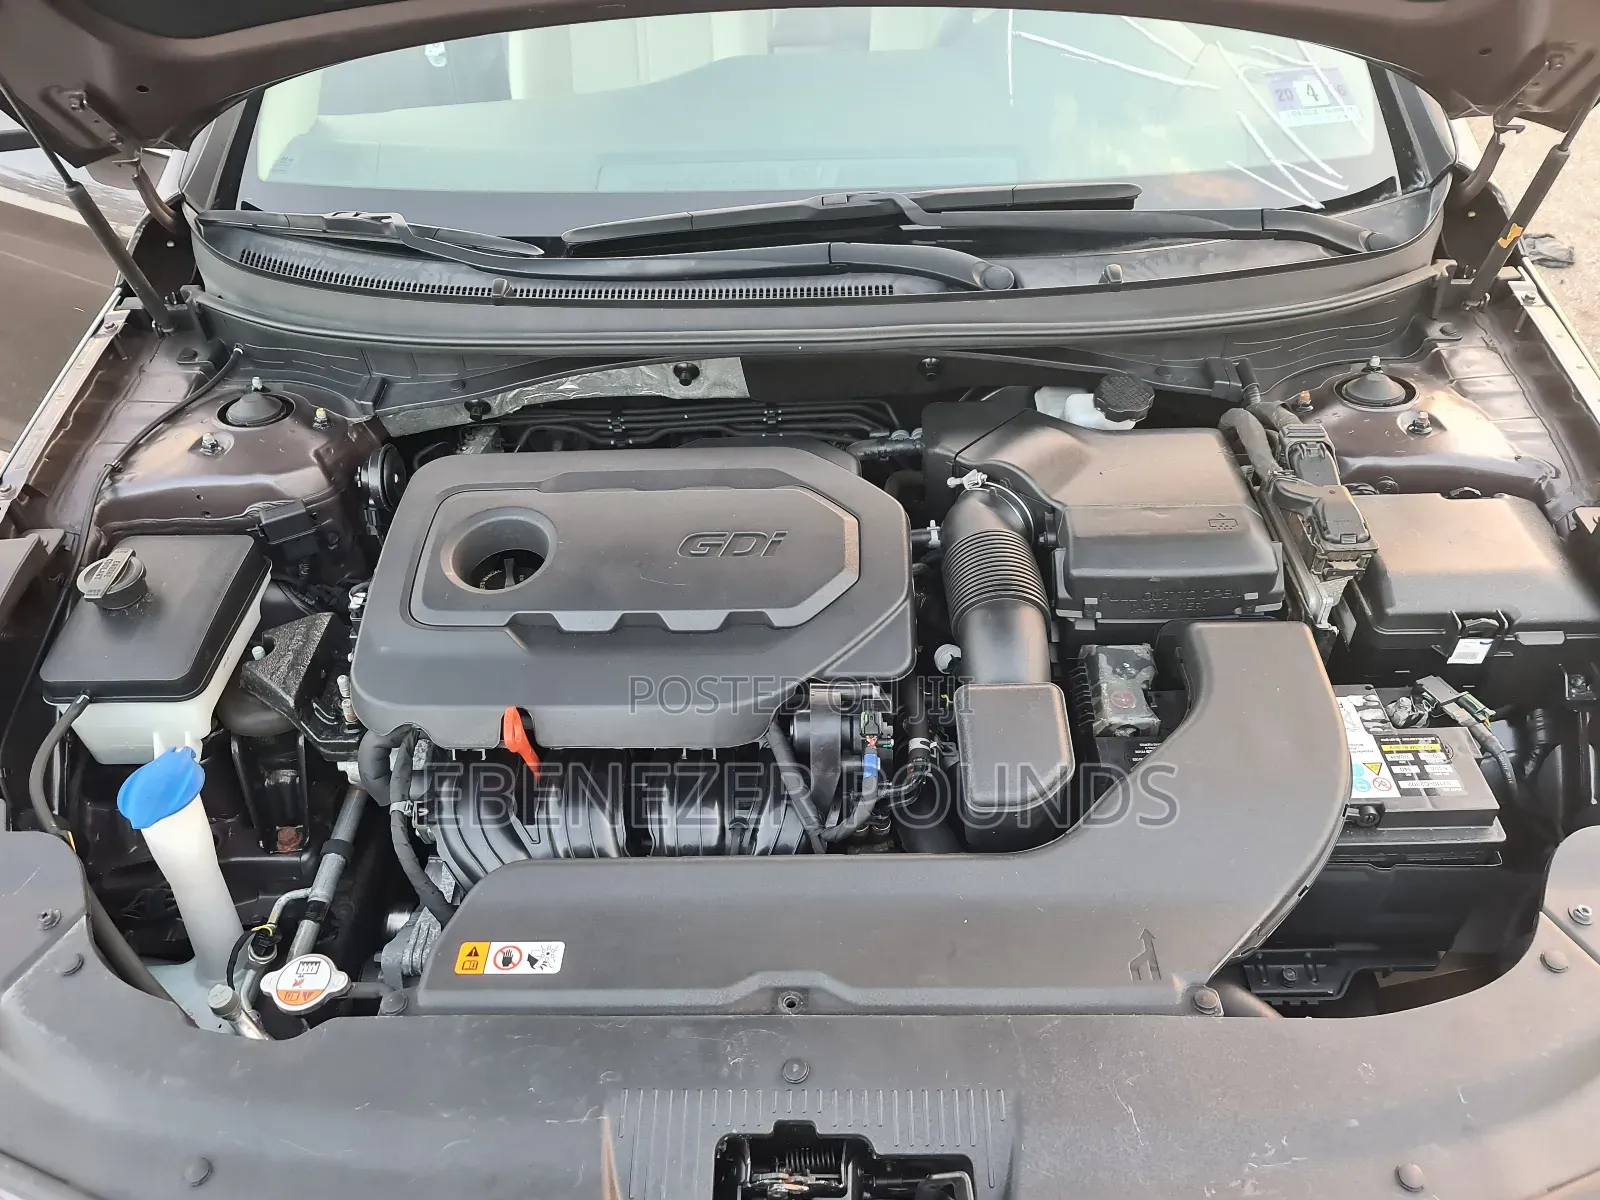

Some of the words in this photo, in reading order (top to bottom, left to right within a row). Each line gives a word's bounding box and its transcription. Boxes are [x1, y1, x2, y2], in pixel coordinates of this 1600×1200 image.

[1275, 87, 1295, 102] 20
[1306, 83, 1319, 102] 4
[676, 530, 789, 559] GDi
[94, 558, 114, 580] COOLANT
[103, 560, 121, 578] ENGINE
[1100, 592, 1138, 602] PULL
[1143, 591, 1175, 601] OUT
[1176, 591, 1196, 601] TO
[1200, 589, 1242, 600] OPEN
